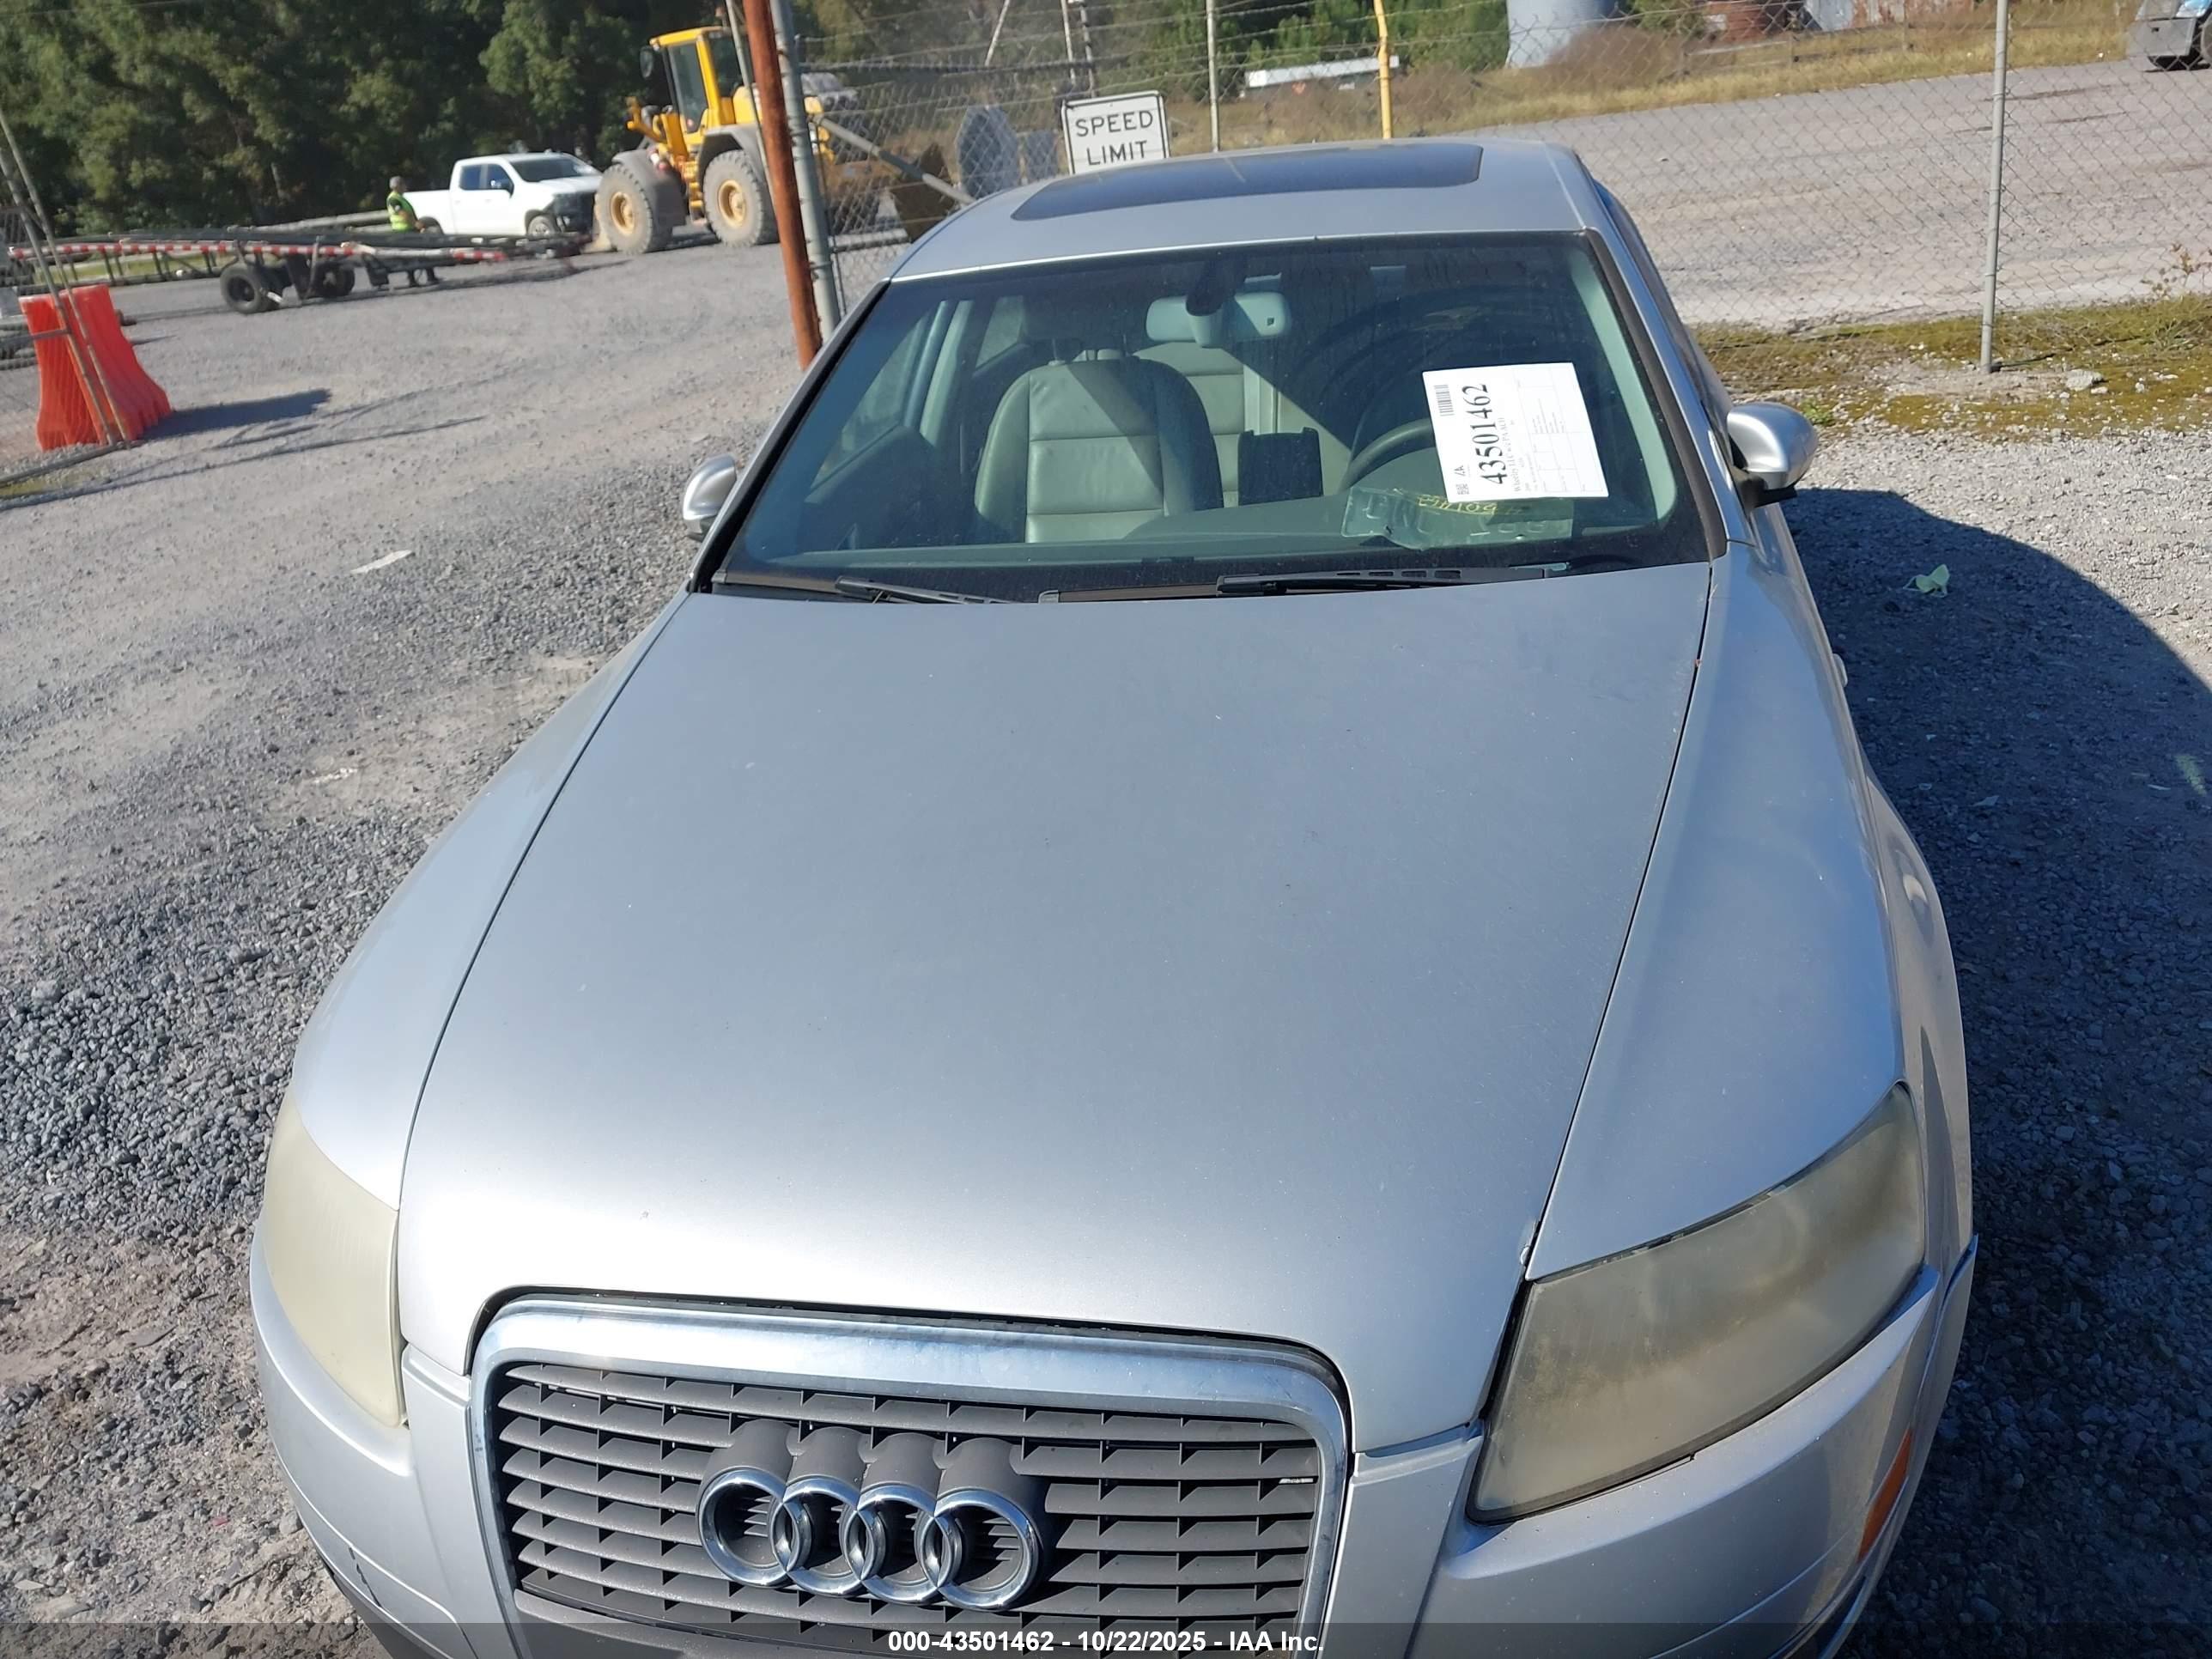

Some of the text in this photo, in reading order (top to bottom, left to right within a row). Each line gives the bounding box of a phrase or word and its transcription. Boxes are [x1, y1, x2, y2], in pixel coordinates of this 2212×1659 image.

[1075, 110, 1153, 137] SPEED
[1086, 140, 1147, 166] LIMIT
[1462, 384, 1508, 485] 43501462
